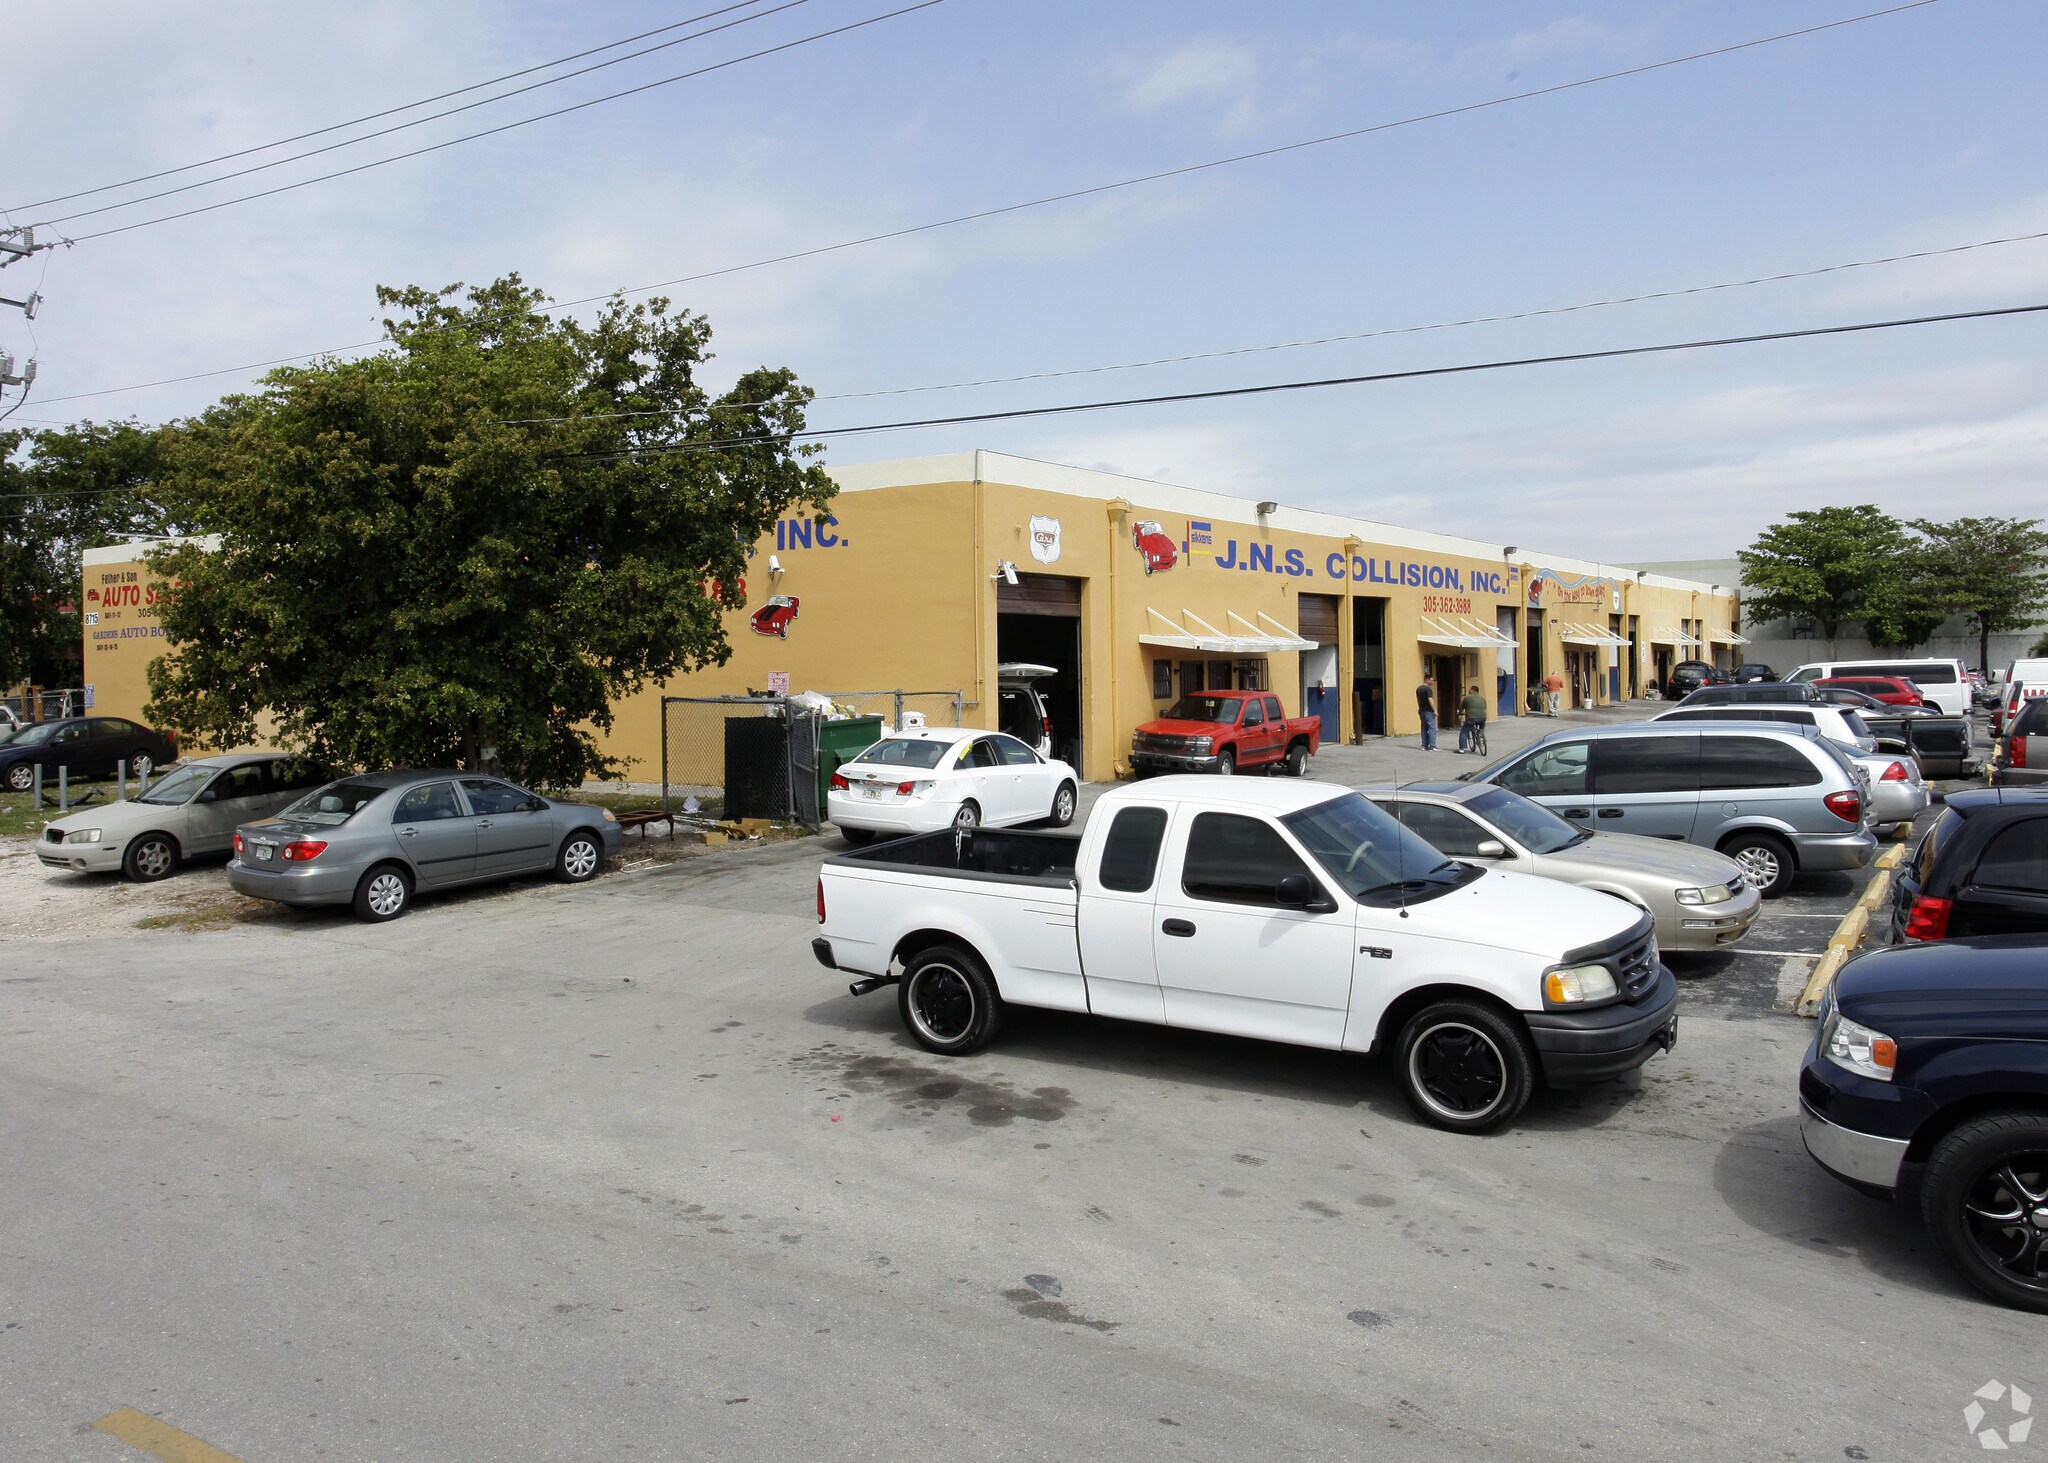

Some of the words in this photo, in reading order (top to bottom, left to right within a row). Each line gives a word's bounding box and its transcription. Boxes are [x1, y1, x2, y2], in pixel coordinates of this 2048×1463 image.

[777, 515, 848, 550] INC.
[1215, 540, 1313, 576] J.N.S.
[1326, 552, 1464, 594] COLLISION,
[1470, 570, 1506, 594] INC.
[102, 573, 120, 584] Father
[127, 571, 137, 582] Son
[102, 585, 140, 608] AUTO
[1423, 595, 1472, 615] 305-362-3988
[85, 613, 98, 624] 8715
[120, 627, 148, 639] AUTO
